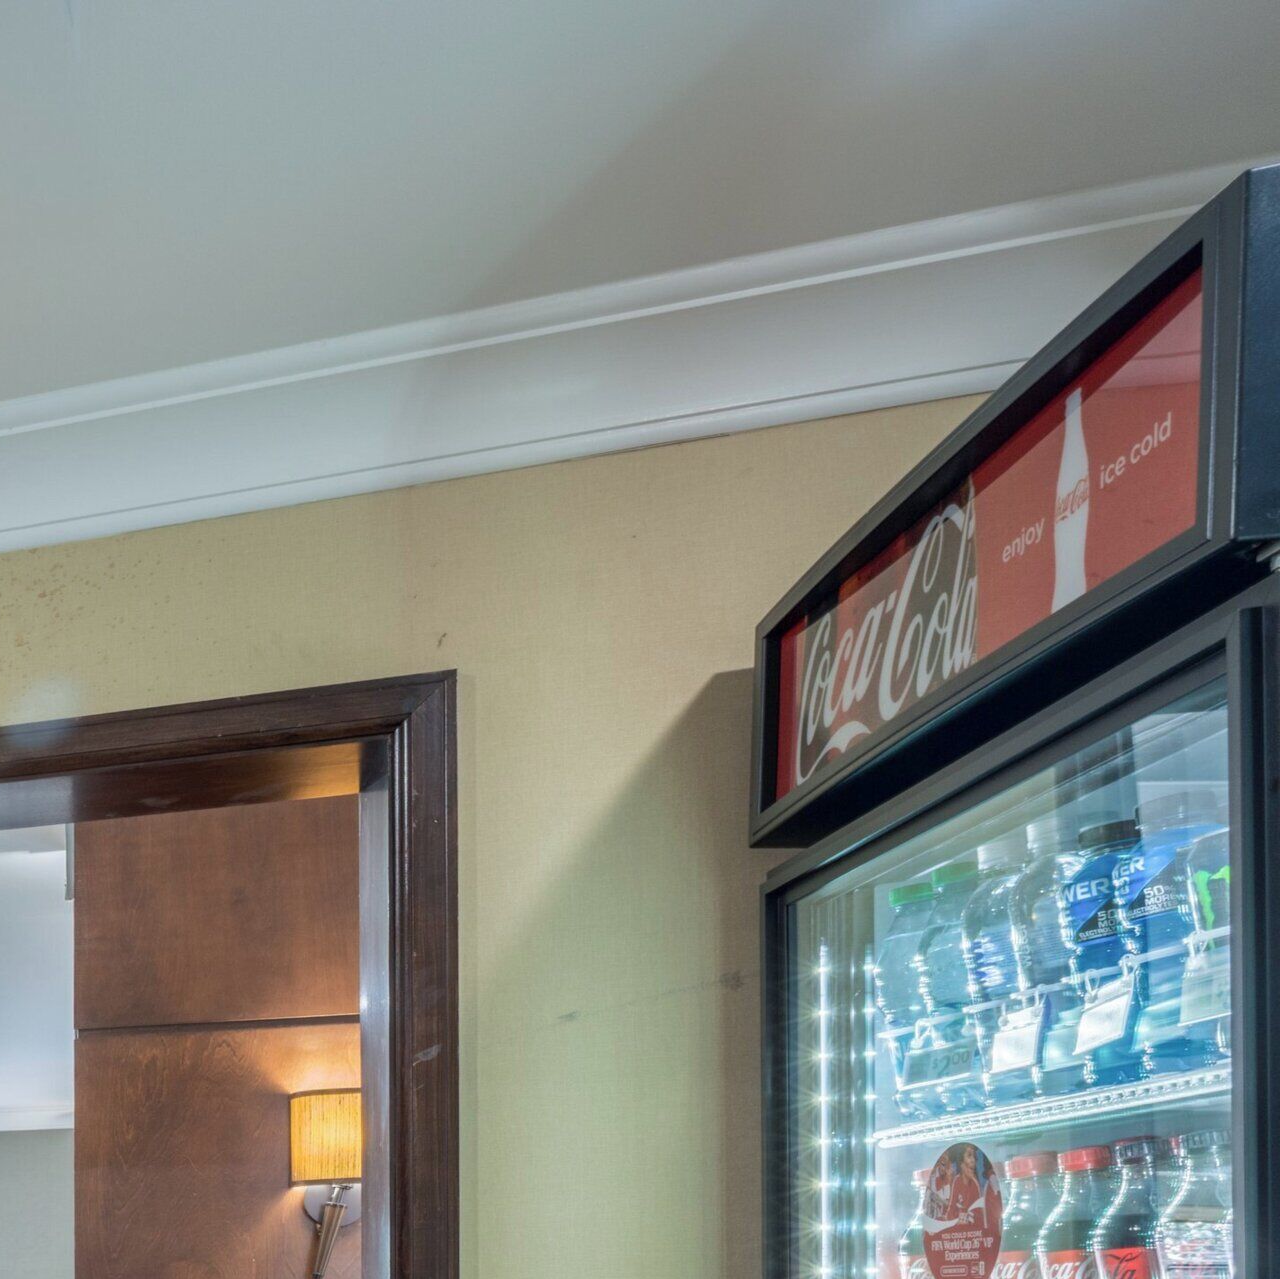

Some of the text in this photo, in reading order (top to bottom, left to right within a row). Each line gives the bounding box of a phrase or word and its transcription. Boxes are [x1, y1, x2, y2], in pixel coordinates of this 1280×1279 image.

[1002, 411, 1172, 563] enjoy ice cold
[796, 500, 978, 785] Coca-Cola
[943, 1239, 959, 1250] World
[960, 1239, 972, 1251] Cup
[945, 1250, 979, 1262] Experiences
